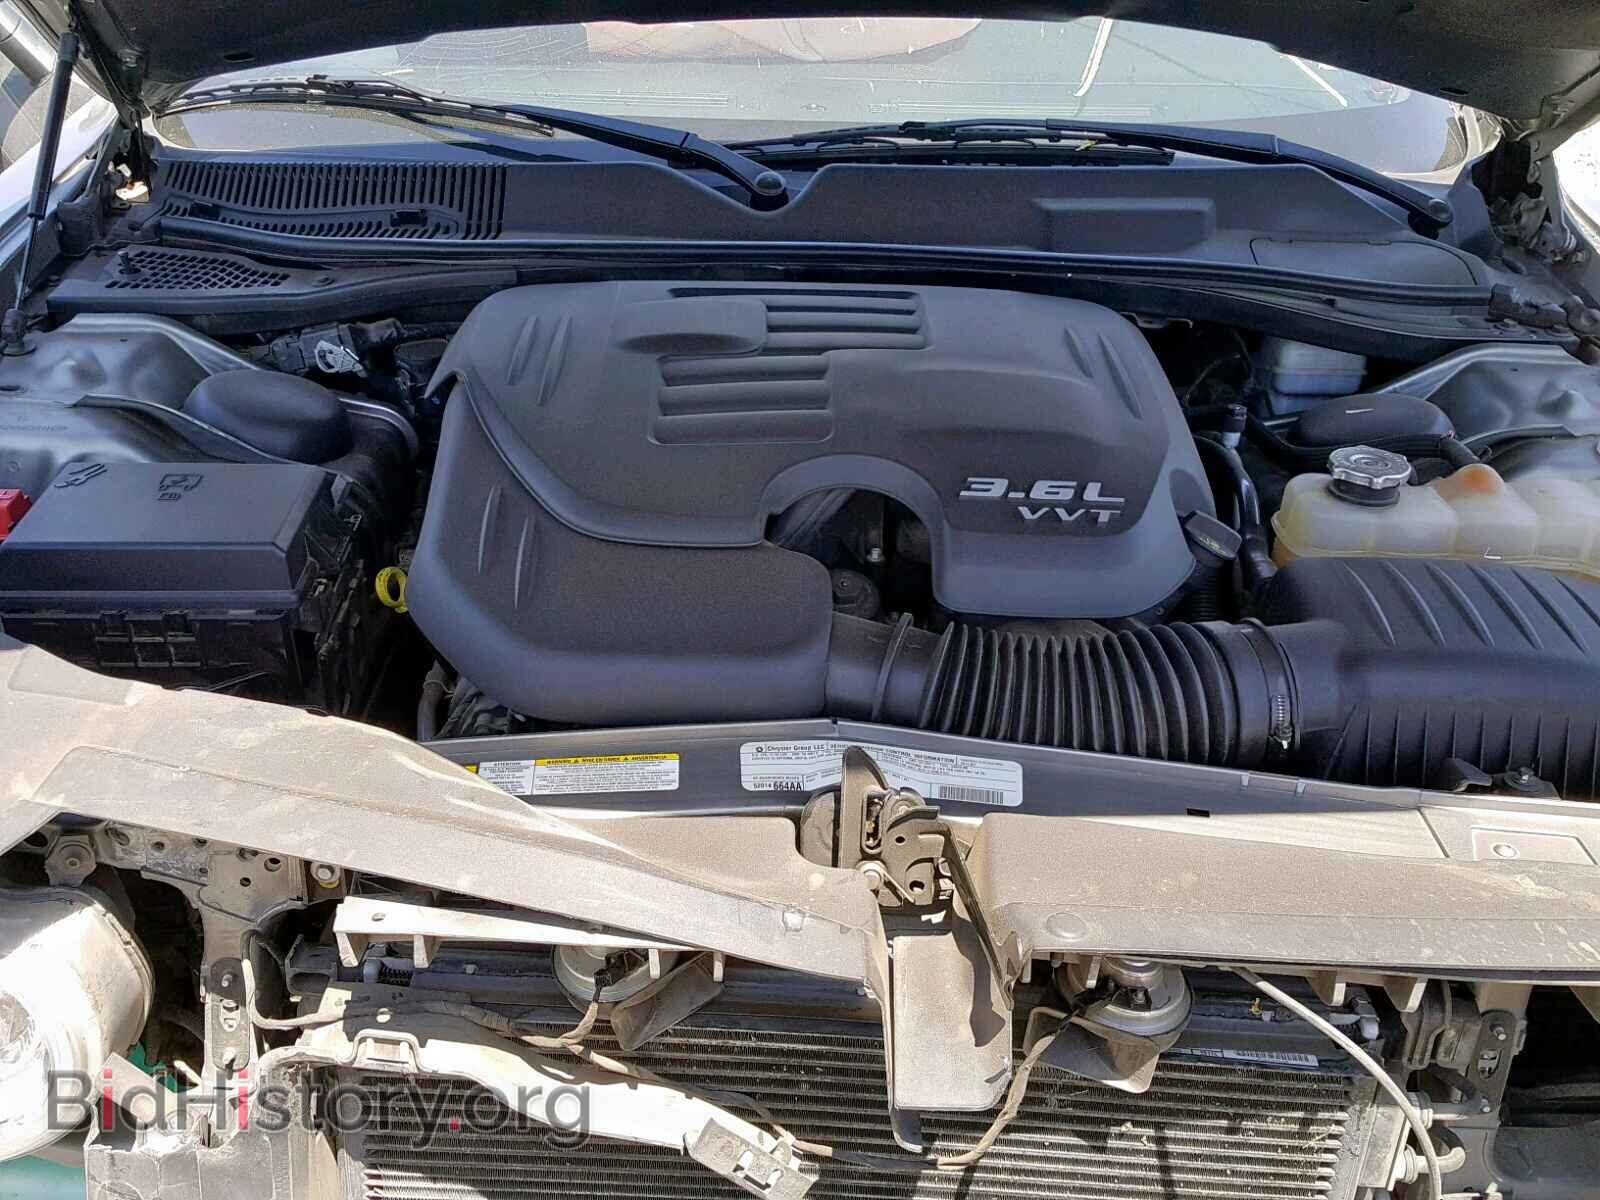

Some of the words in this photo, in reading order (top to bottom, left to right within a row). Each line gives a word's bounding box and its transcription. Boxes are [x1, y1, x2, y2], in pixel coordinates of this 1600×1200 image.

[959, 477, 1125, 502] 3.6L
[1017, 506, 1121, 523] VVT
[886, 748, 912, 758] CONTROL
[914, 753, 955, 763] INFORMATION
[773, 782, 802, 790] 664AA
